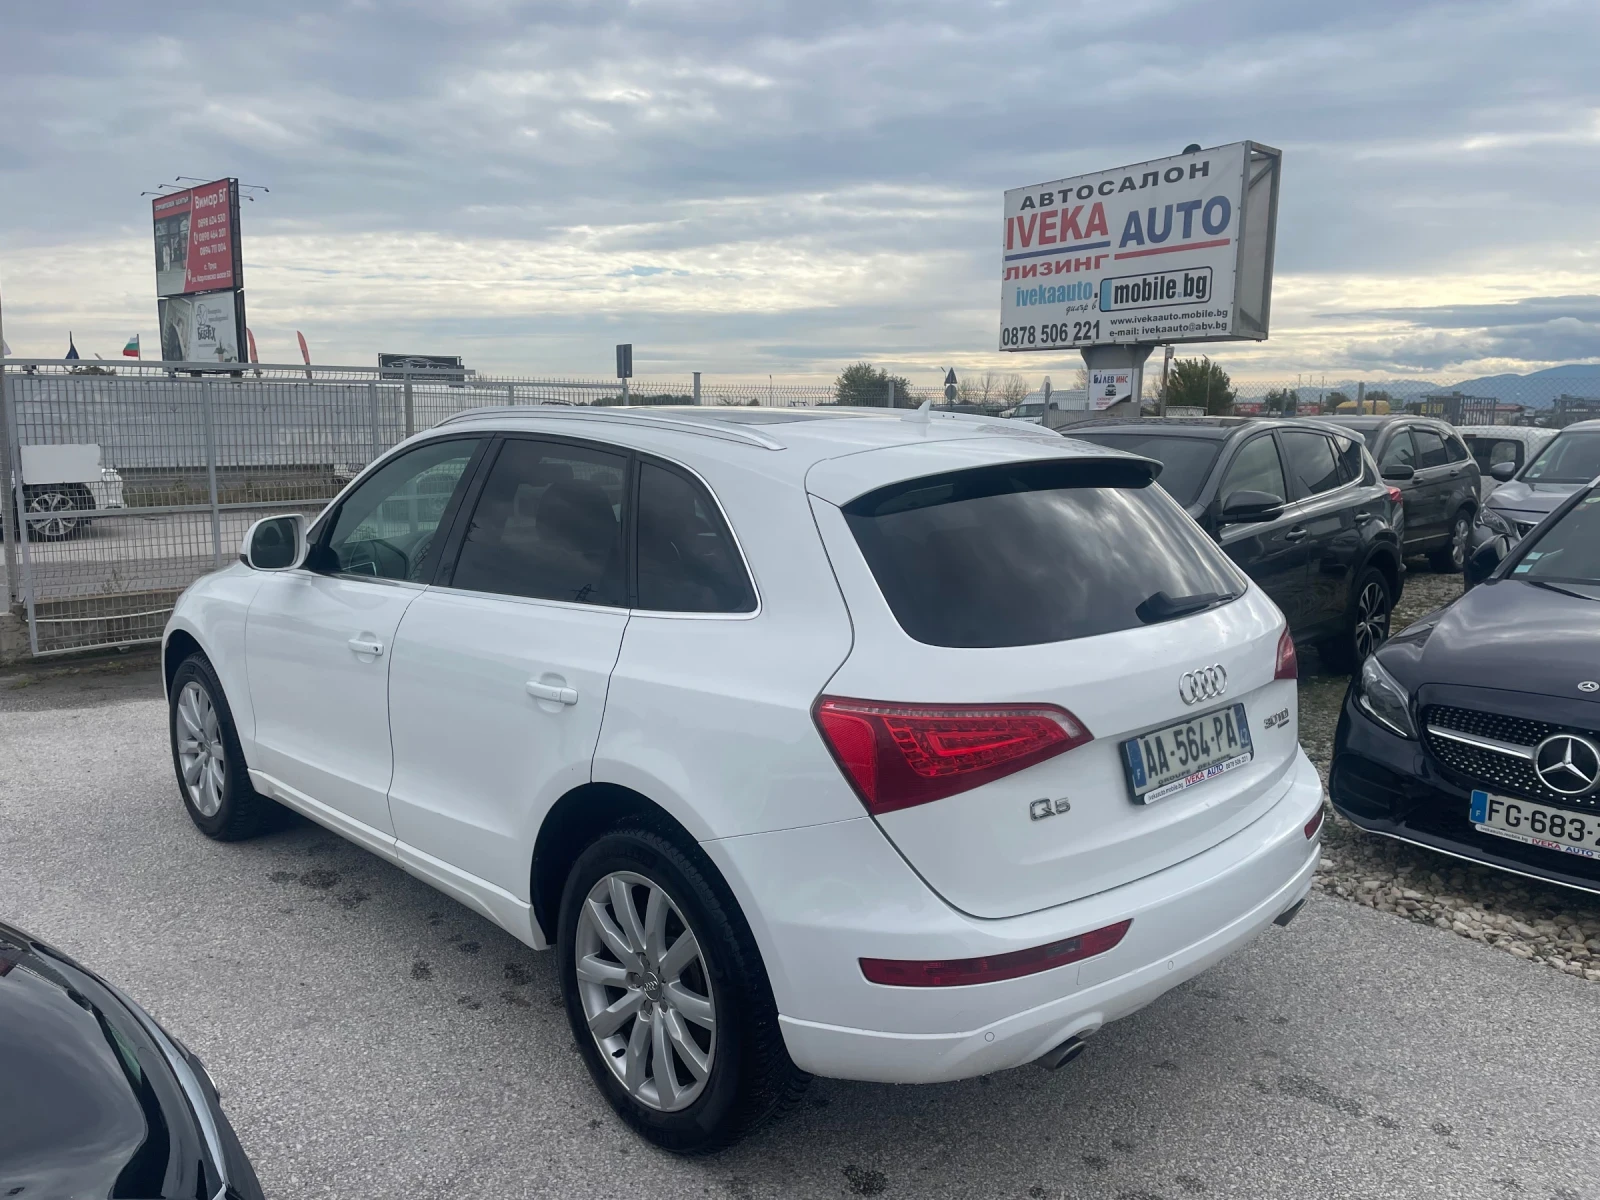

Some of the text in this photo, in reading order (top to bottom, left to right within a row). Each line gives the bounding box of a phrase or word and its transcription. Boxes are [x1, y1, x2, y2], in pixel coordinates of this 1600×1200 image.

[1020, 160, 1210, 211] АВТОСАЛОН
[1006, 195, 1232, 251] IVEKA AUTO
[1004, 254, 1109, 281] ЛИЗИНГ
[1114, 272, 1208, 305] mobile.bg
[1109, 320, 1228, 338] e-mail: ivekaauto@abv.bg
[1110, 308, 1228, 326] www.ivekaauto.mobile.bg
[1002, 319, 1101, 346] 0878 506 221
[1143, 712, 1238, 779] AA-564-PA
[1184, 772, 1205, 785] IVEKA
[1206, 763, 1224, 776] AUTO
[1029, 797, 1071, 821] Q5
[1532, 838, 1562, 851] IVEKA
[1565, 845, 1594, 858] AUTO
